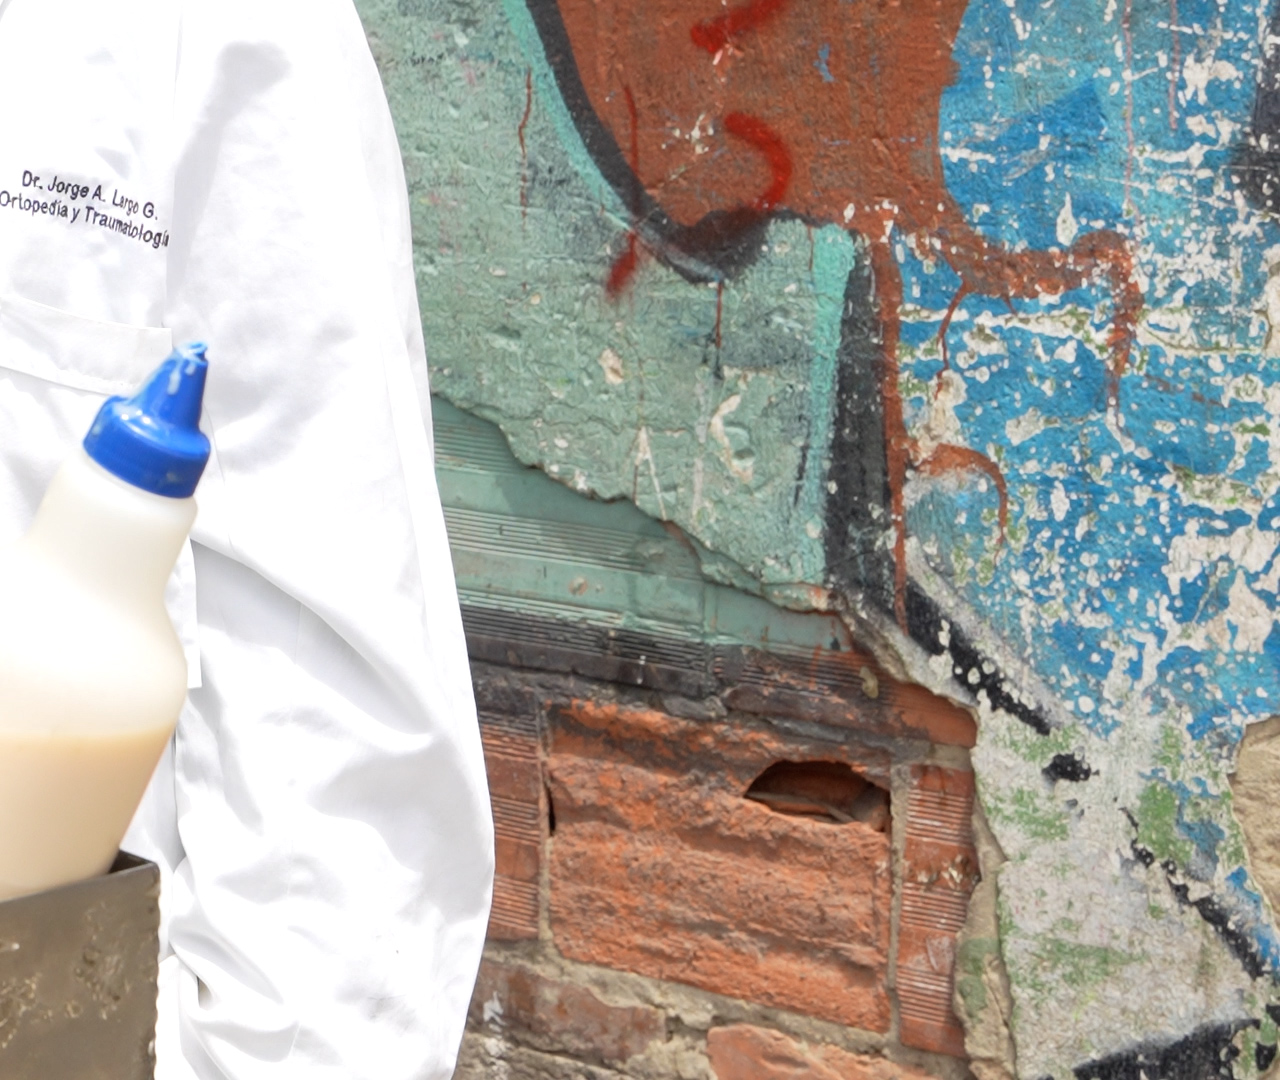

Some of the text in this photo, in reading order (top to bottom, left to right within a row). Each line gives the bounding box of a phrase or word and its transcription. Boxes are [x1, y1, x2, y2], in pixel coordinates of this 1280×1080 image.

[22, 170, 158, 220] Dr. Jorge A. Largo G.
[70, 207, 80, 224] y
